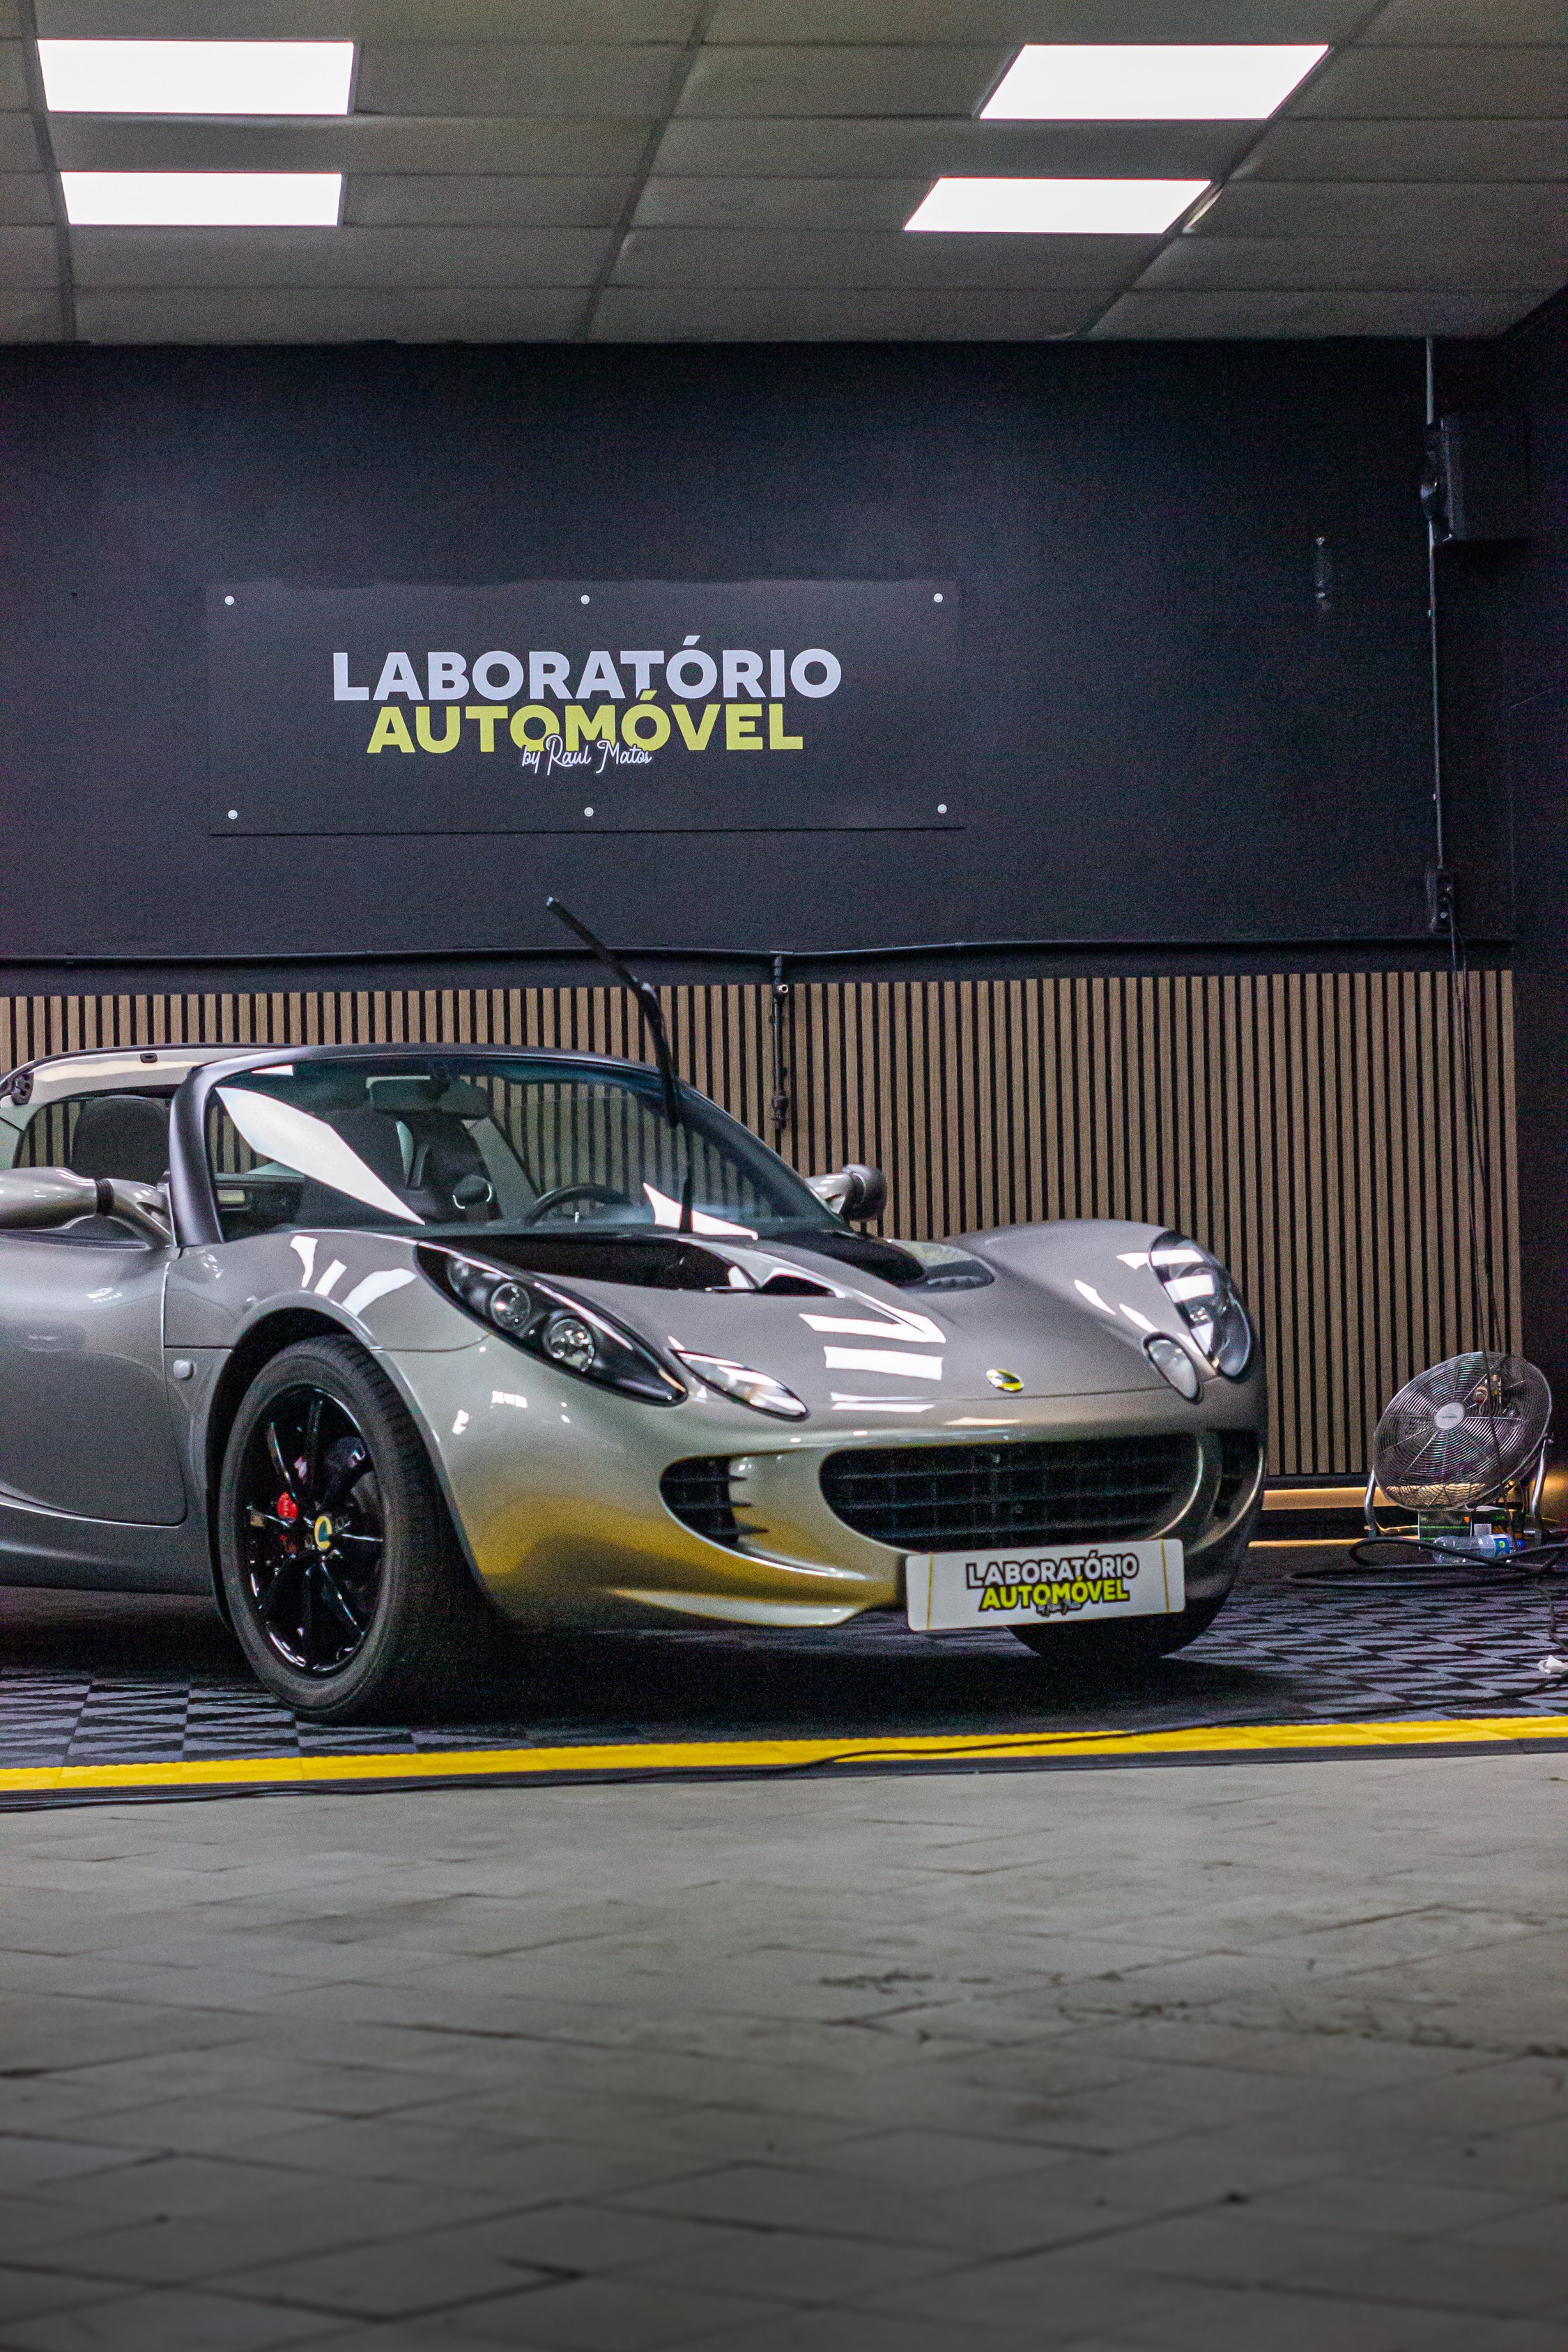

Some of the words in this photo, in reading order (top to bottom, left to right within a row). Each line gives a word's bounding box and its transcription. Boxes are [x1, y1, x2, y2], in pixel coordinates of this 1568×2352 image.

[333, 636, 841, 700] LABORATÓRIO
[367, 690, 804, 753] AUTOMÓVEL
[521, 745, 541, 774] by
[546, 734, 592, 776] Raul
[596, 739, 653, 774] Matos
[966, 1550, 1139, 1589] LABORATÓRIO
[978, 1575, 1130, 1612] AUTOMÓVEL
